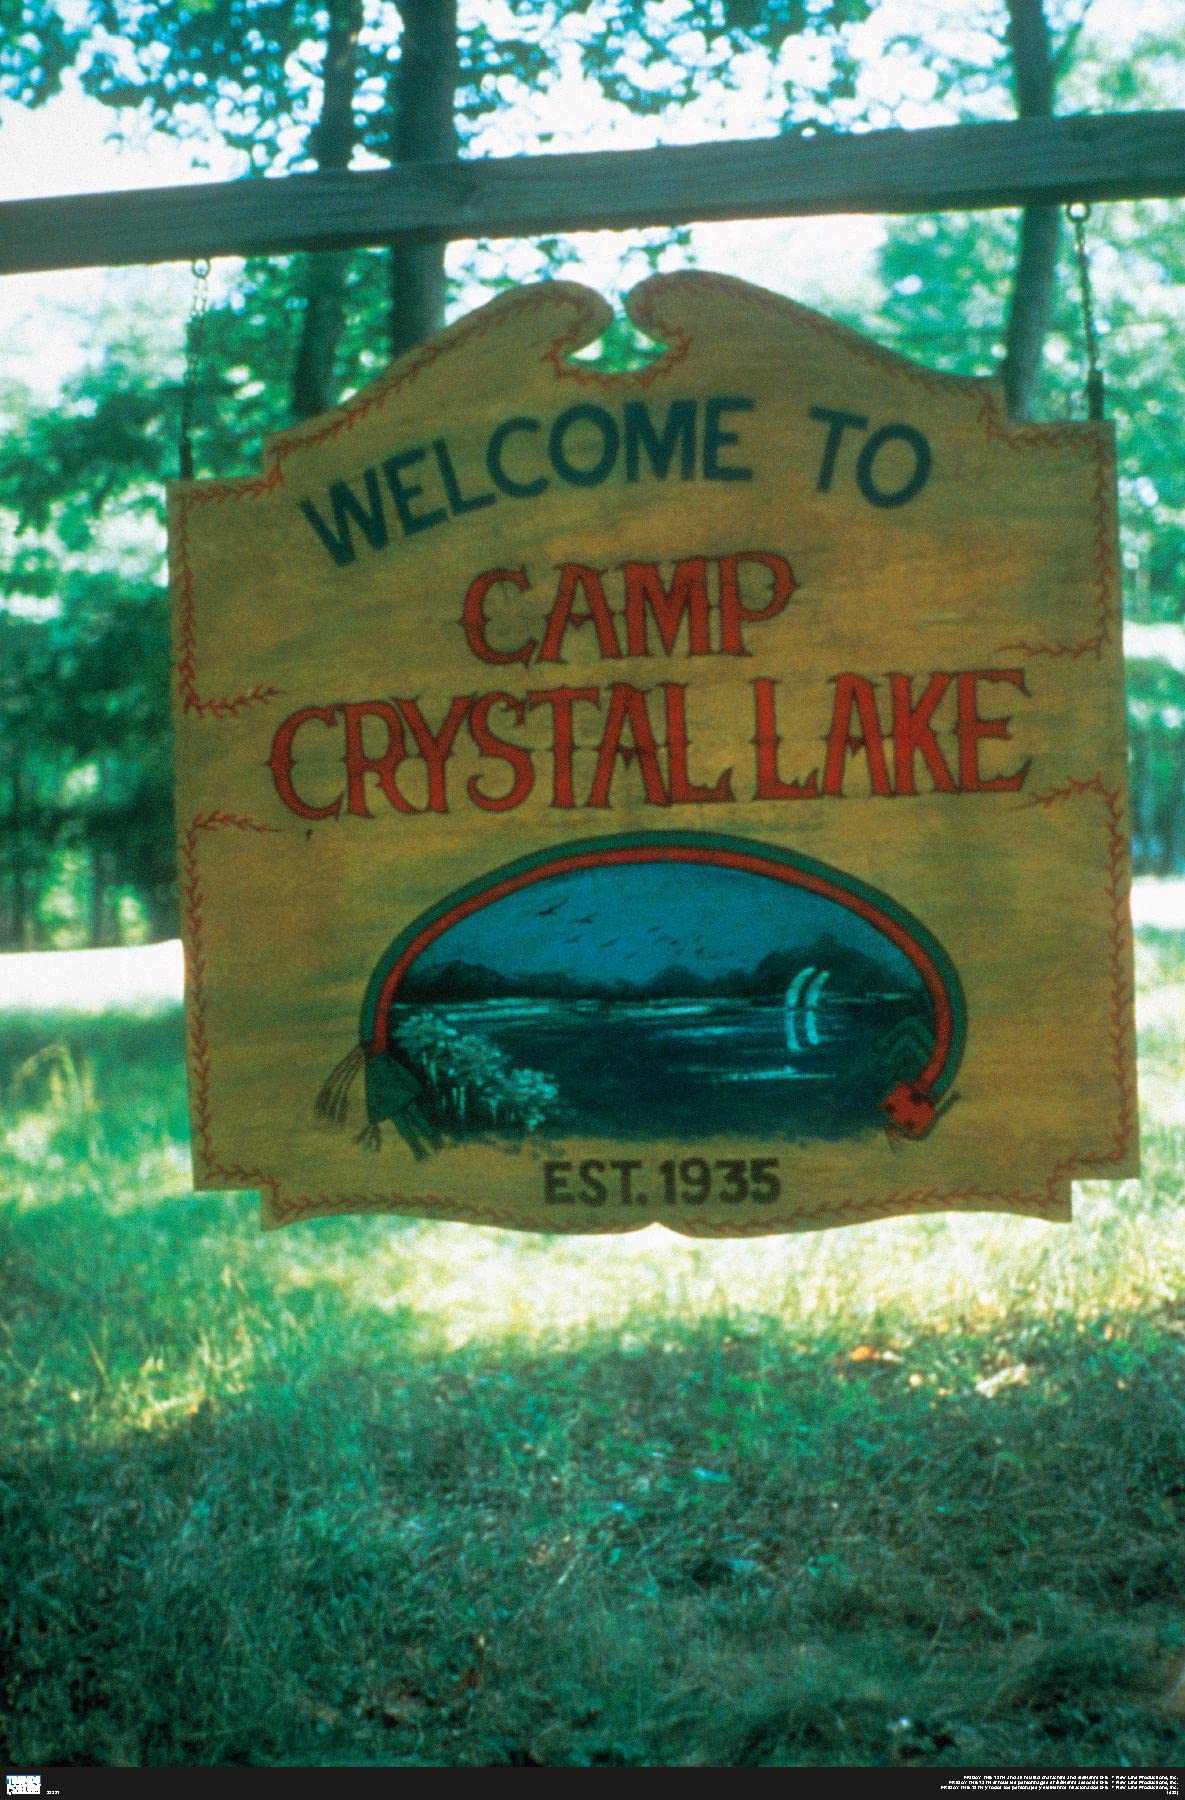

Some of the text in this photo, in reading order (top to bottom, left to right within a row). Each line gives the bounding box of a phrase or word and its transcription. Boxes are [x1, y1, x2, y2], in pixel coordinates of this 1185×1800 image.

[299, 397, 931, 567] WELCOME TO
[459, 551, 800, 667] CAMP
[266, 668, 1032, 821] CRYSTAL LAKE
[543, 1157, 781, 1205] EST. 1935
